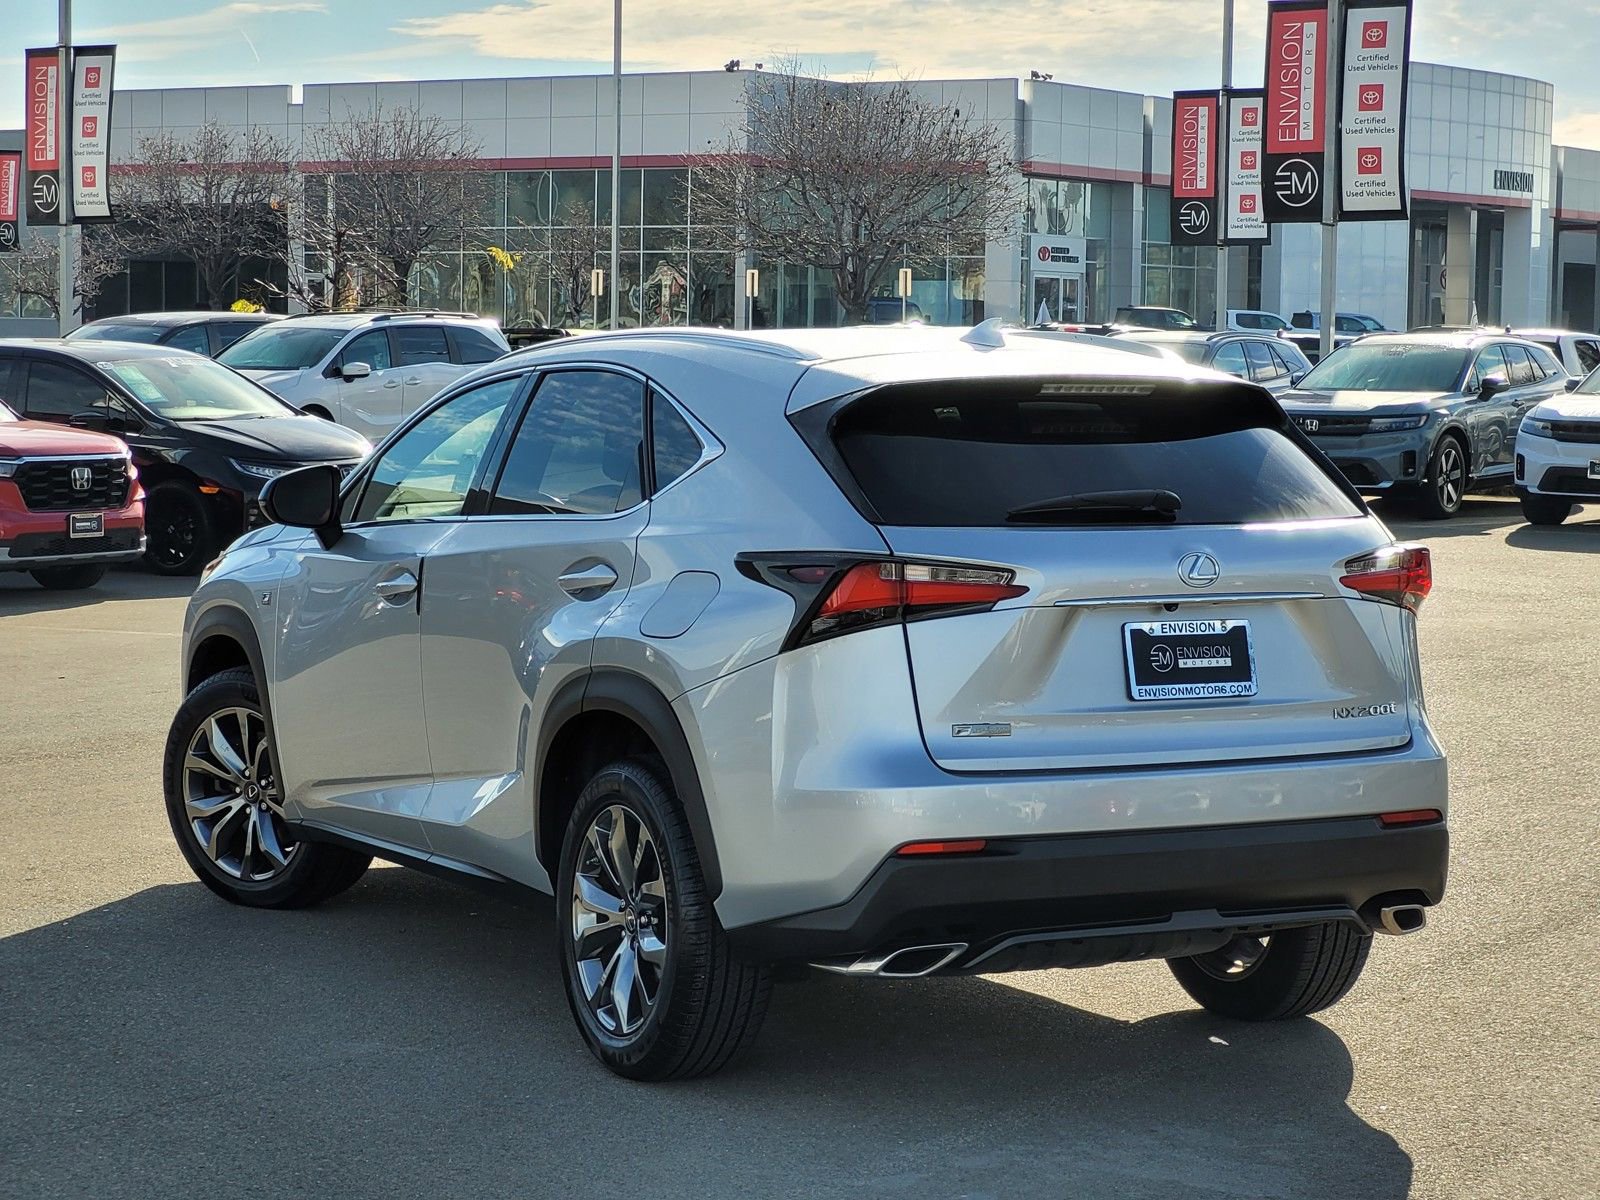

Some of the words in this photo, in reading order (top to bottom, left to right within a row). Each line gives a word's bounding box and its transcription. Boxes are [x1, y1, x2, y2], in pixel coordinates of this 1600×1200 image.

[1367, 63, 1399, 71] Vehicles
[1279, 22, 1301, 142] ENVISION
[1303, 33, 1314, 130] MOTORS
[35, 66, 48, 161] ENVISION
[1354, 117, 1386, 125] Certified
[1345, 127, 1364, 135] Used
[1365, 126, 1396, 134] Vehicles
[1182, 106, 1198, 190] ENVISION
[1, 160, 10, 215] ENVISION
[1354, 180, 1386, 188] Certified
[1494, 169, 1534, 193] ENVISION
[1365, 189, 1396, 197] Vehicles
[1160, 622, 1216, 634] ENVISION
[1176, 645, 1231, 659] ENVISION
